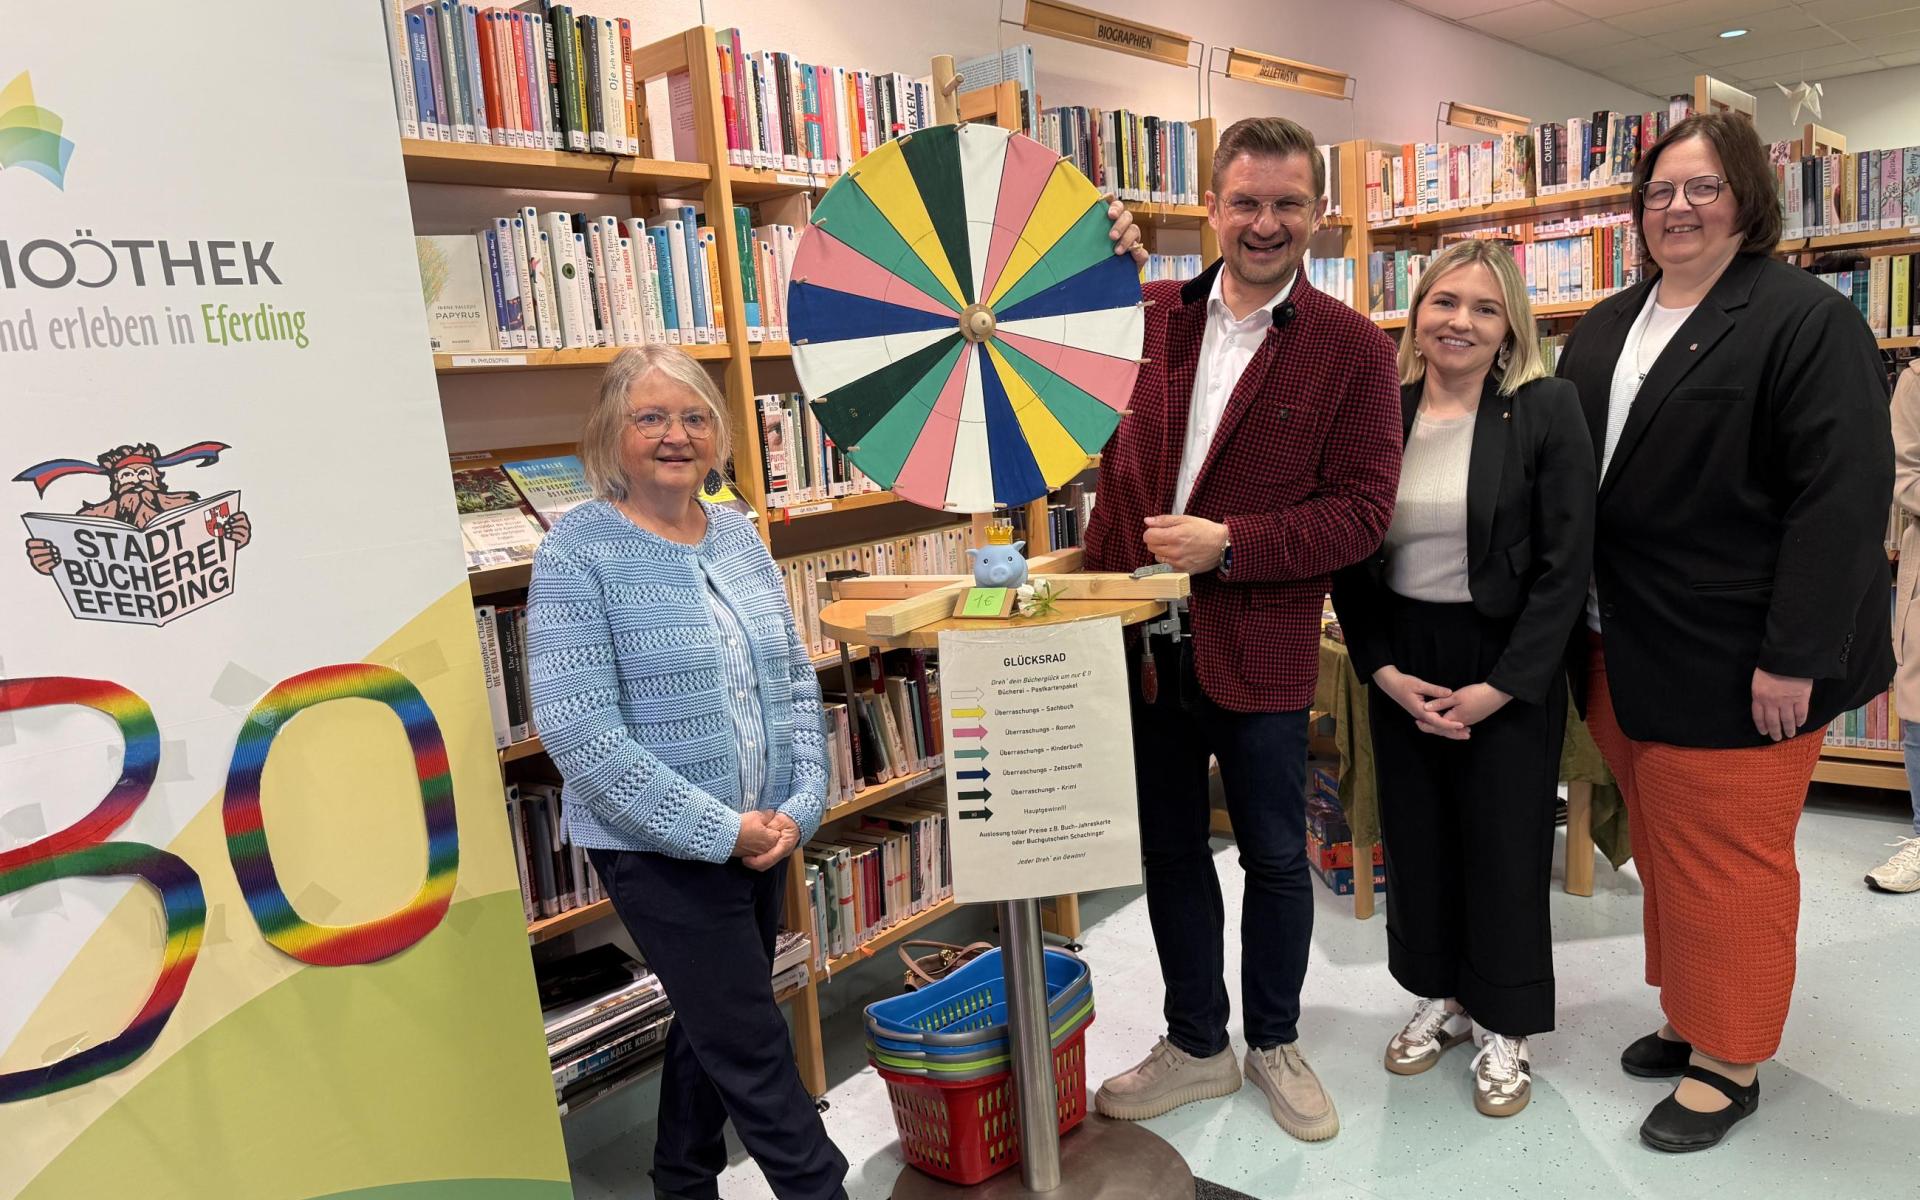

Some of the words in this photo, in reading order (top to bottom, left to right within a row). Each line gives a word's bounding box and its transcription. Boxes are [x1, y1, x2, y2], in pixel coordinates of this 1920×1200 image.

[544, 22, 556, 60] MÄDCHEN
[1098, 25, 1152, 50] BIOGRAPHIEN
[609, 75, 618, 90] Oje
[626, 65, 634, 100] Jungen
[1260, 64, 1298, 84] BELLETRISTIK
[564, 222, 573, 258] Harari
[622, 250, 632, 274] DENKEN
[626, 275, 634, 290] TIERE
[538, 289, 549, 324] HUNDERT
[600, 283, 608, 324] PROVOKATION
[436, 312, 480, 320] PAPYRUS
[49, 306, 158, 350] erleben
[165, 306, 195, 345] in
[201, 303, 309, 349] Eferding
[74, 520, 186, 564] STADT
[63, 536, 227, 593] BÜCHEREI
[74, 567, 230, 618] EFERDING
[476, 616, 485, 640] Clark
[484, 616, 500, 674] SCHLAFWANDLER
[480, 641, 492, 689] Christopher
[1003, 652, 1066, 667] GLÜCKSRAD
[493, 674, 502, 687] DIE
[998, 687, 1024, 696] Bücherei
[1031, 682, 1078, 694] Postkartenpaket
[1010, 676, 1022, 685] dein
[1022, 673, 1060, 684] Bücherglück
[994, 706, 1040, 716] Überraschungs
[1046, 703, 1074, 712] Sachbuch
[1005, 728, 1050, 736] Überraschungs
[1000, 748, 1044, 757] Überraschungs
[1050, 743, 1084, 752] Kinderbuch
[1002, 767, 1048, 776] Überraschungs
[1054, 762, 1082, 772] Zeitschrift
[1010, 786, 1056, 796] Überraschungs
[979, 830, 1010, 838] Auslosung
[1011, 828, 1028, 836] toller
[1060, 819, 1111, 832] Buch-Jahreskarte
[1026, 834, 1069, 846] Buchgutschein
[1070, 830, 1105, 841] Schachinger
[1017, 858, 1034, 866] Jeder
[610, 1040, 632, 1058] KALTE
[635, 1030, 657, 1047] KRIEG
